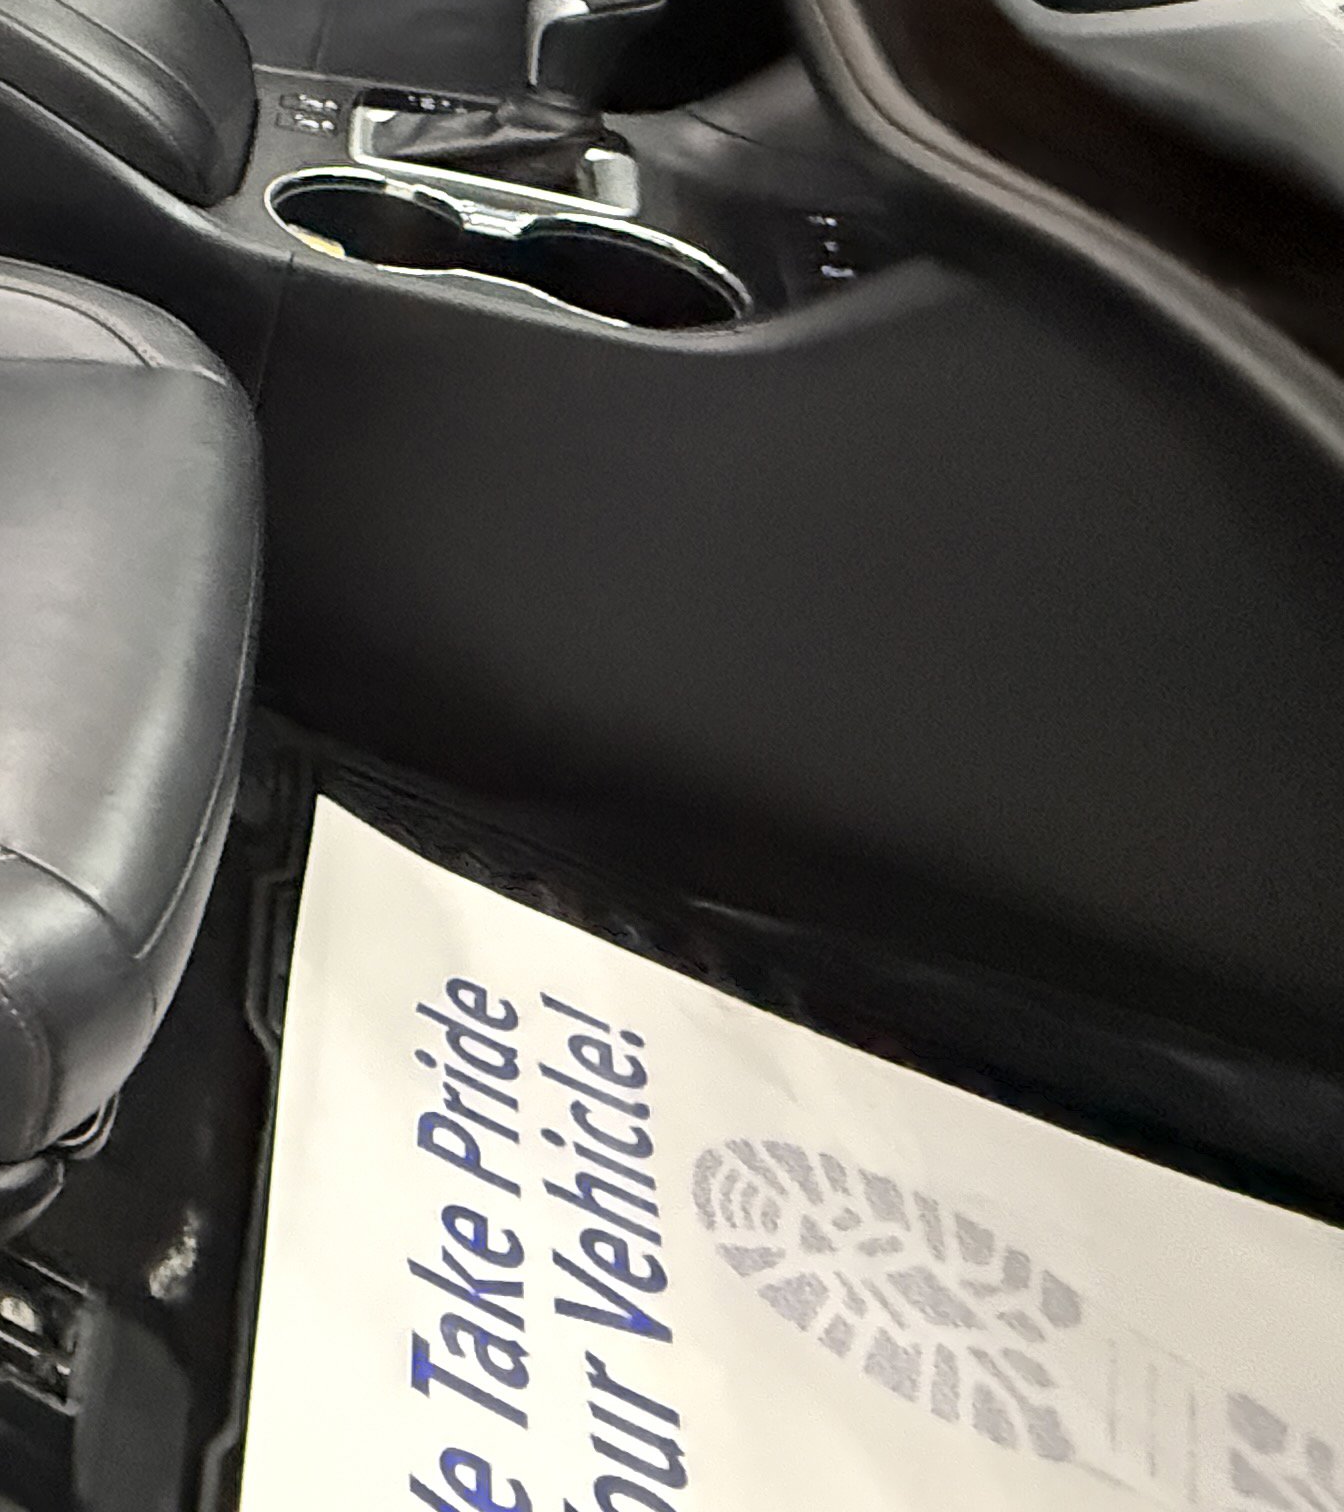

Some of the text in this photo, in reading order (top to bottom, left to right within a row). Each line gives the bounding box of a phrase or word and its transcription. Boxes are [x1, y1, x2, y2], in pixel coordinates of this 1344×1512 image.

[407, 978, 533, 1512] e Take Pride
[538, 992, 689, 1512] our Vehicle!
